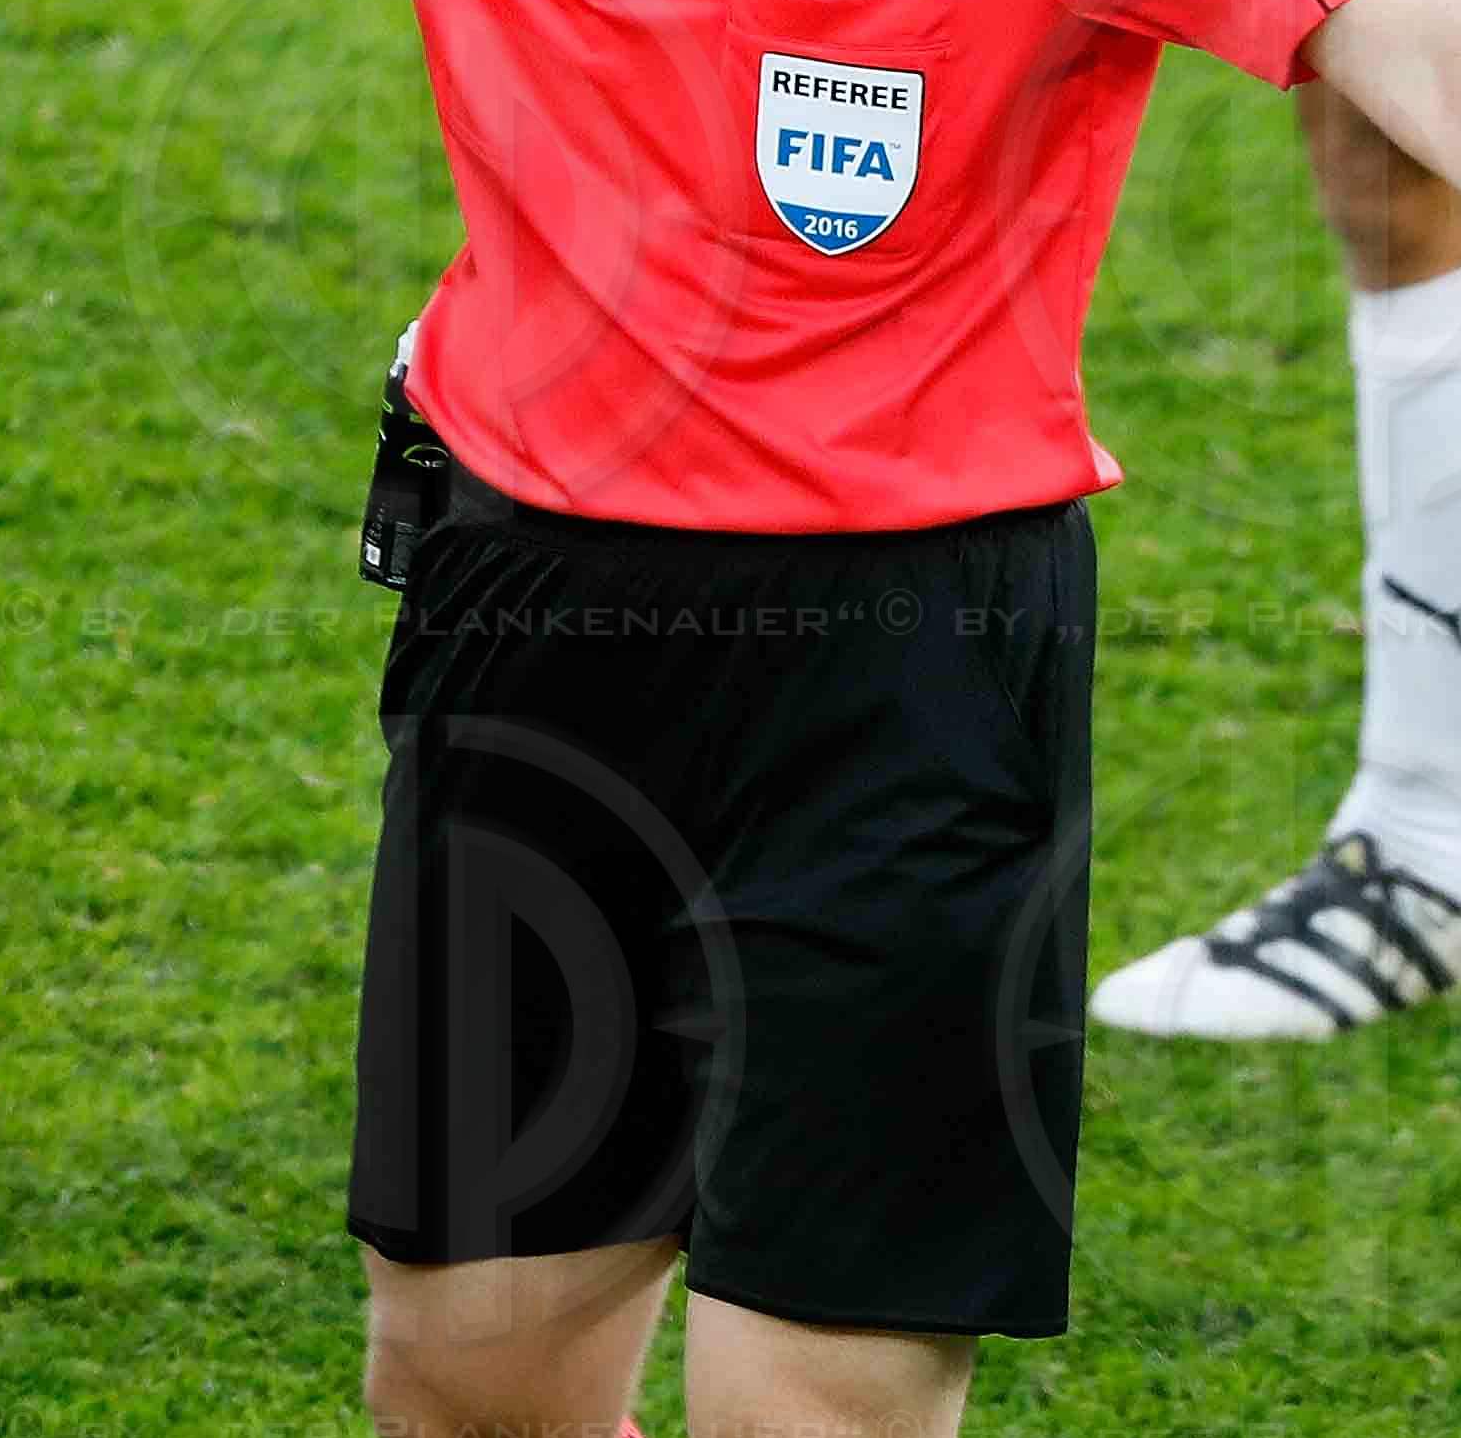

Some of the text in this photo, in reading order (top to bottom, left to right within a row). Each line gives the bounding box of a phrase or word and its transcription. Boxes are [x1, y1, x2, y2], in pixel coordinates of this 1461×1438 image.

[771, 69, 909, 110] REFEREE
[775, 127, 895, 182] FIFA
[803, 214, 858, 239] 2016
